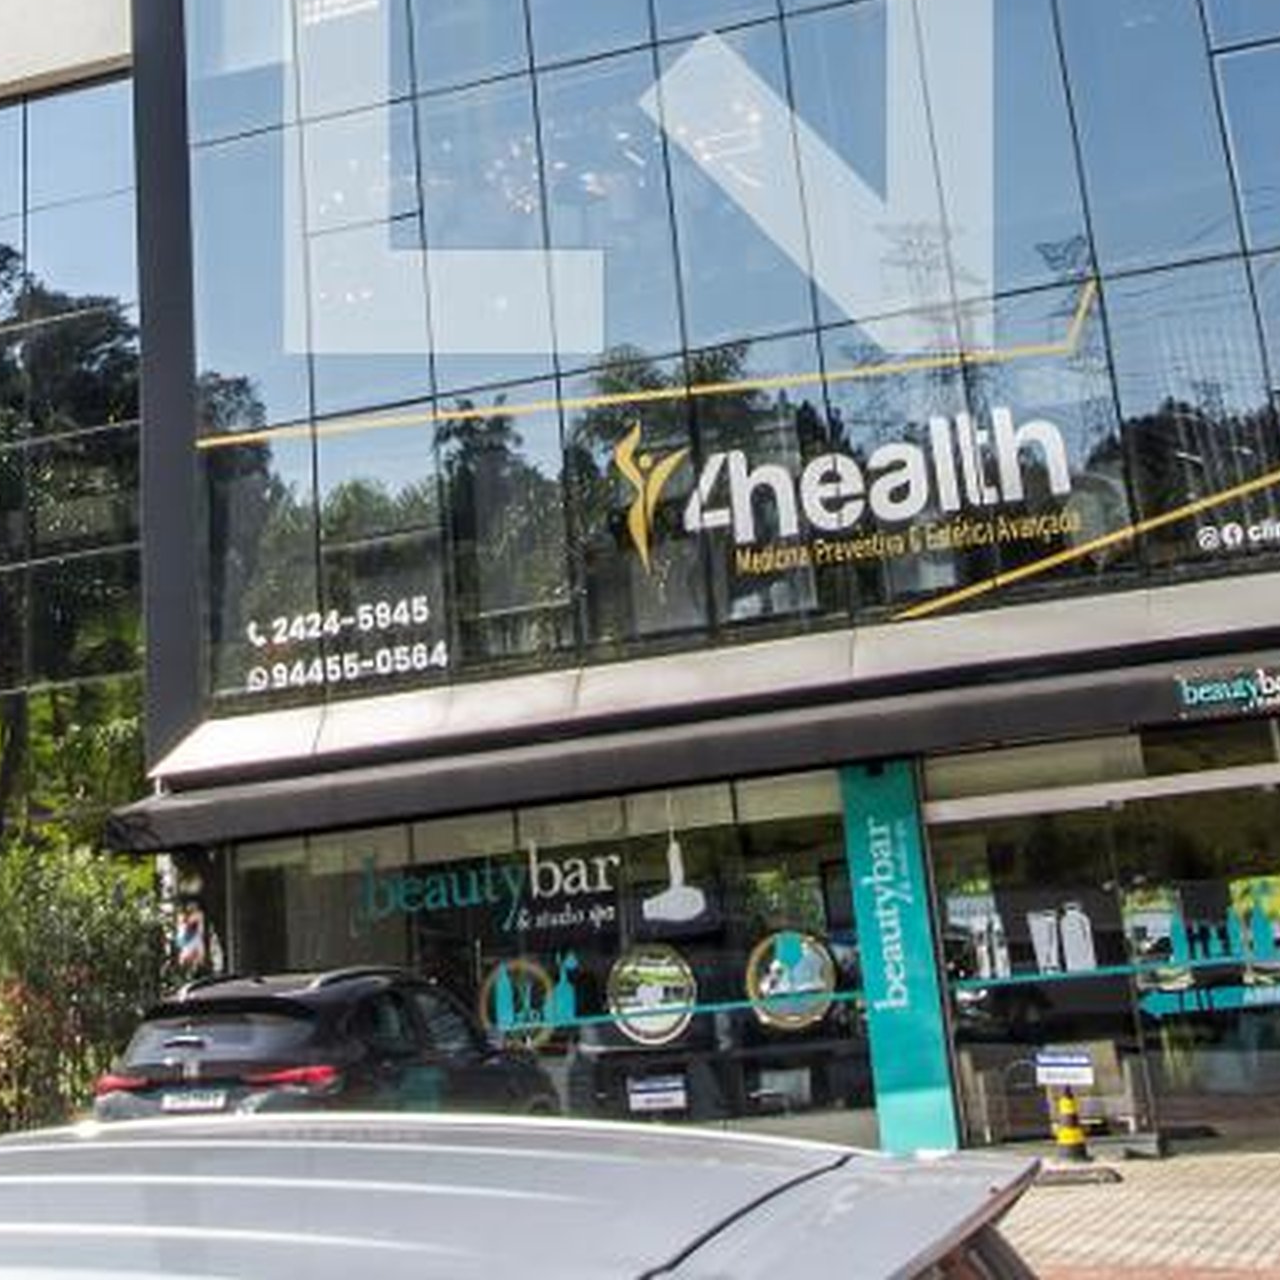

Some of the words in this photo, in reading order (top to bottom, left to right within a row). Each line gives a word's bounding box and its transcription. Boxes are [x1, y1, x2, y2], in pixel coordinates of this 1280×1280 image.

[684, 406, 1072, 544] 4health
[815, 528, 906, 565] Preventiva
[270, 640, 449, 689] 94455-0564
[860, 815, 913, 1013] beautybar
